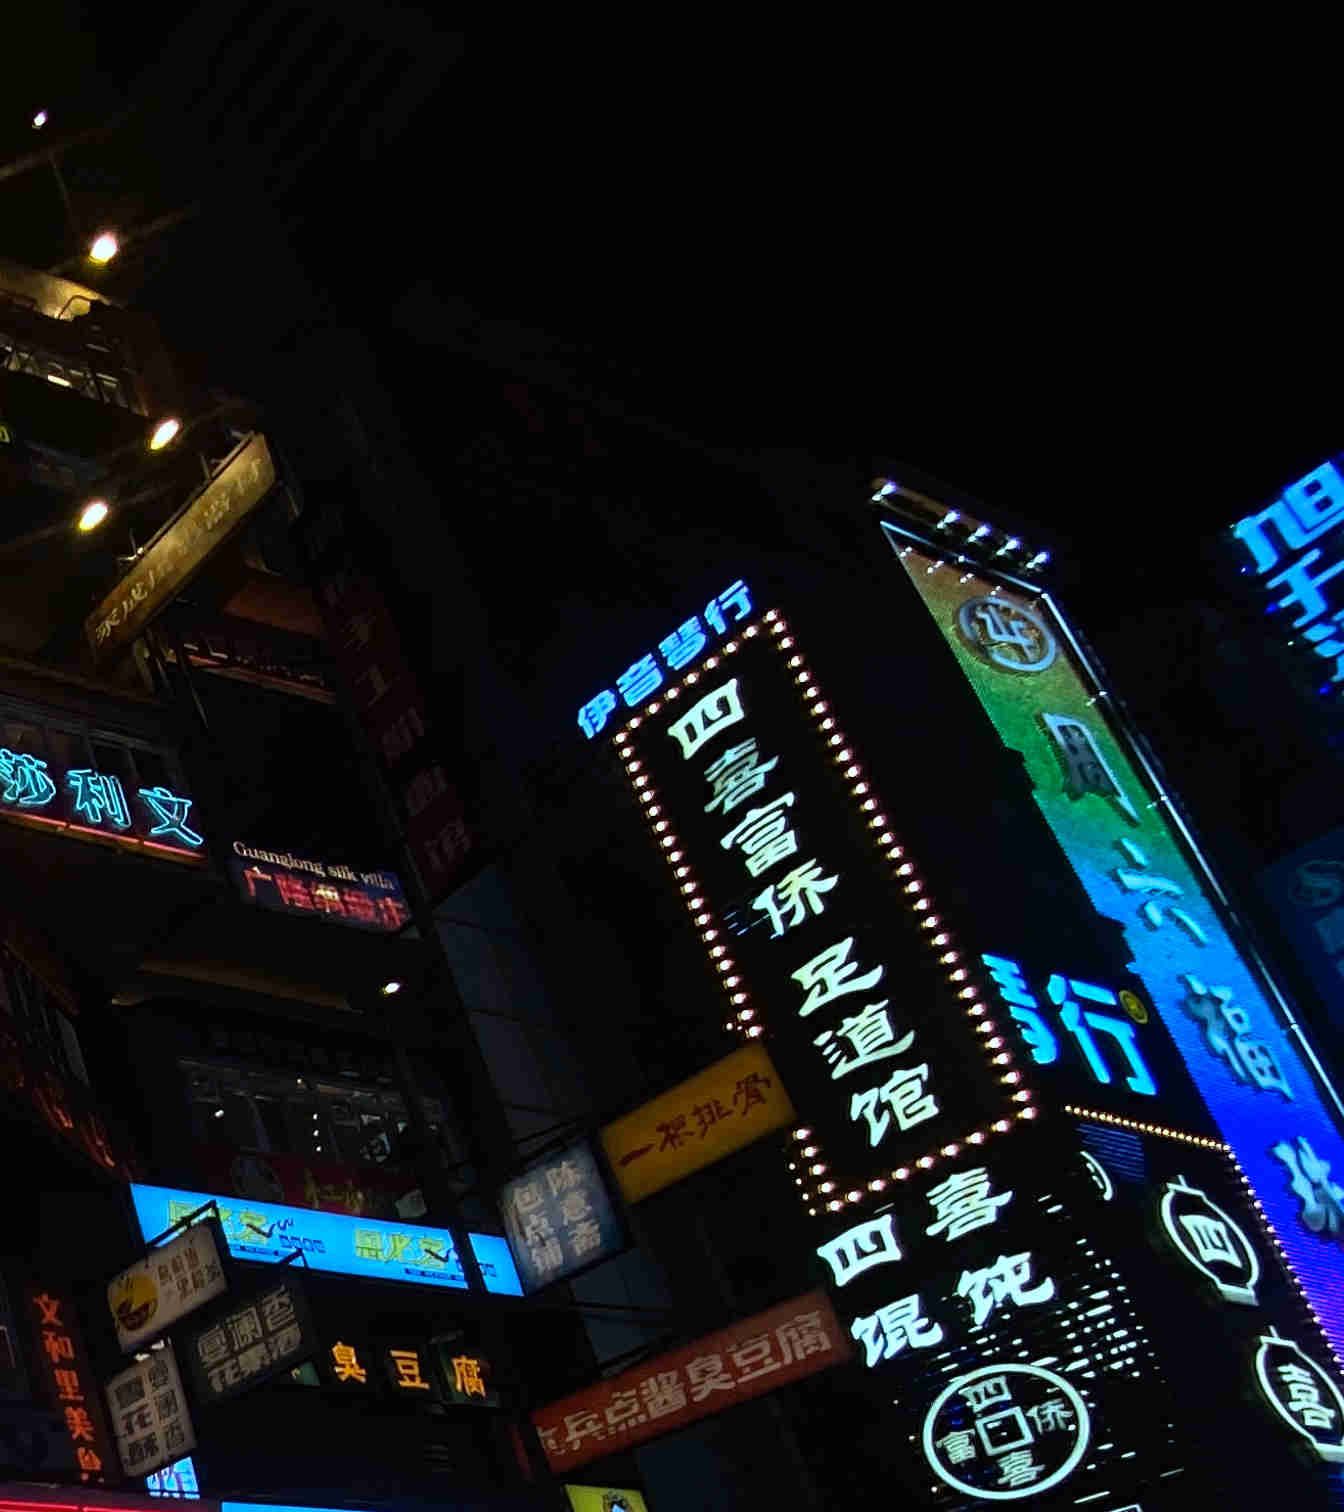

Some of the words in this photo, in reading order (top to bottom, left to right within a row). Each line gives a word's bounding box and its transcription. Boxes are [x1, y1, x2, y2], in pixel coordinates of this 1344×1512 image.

[815, 1166, 1013, 1288] 四喜
[849, 1251, 1057, 1368] 馄饨
[328, 1340, 489, 1400] 臭豆腐
